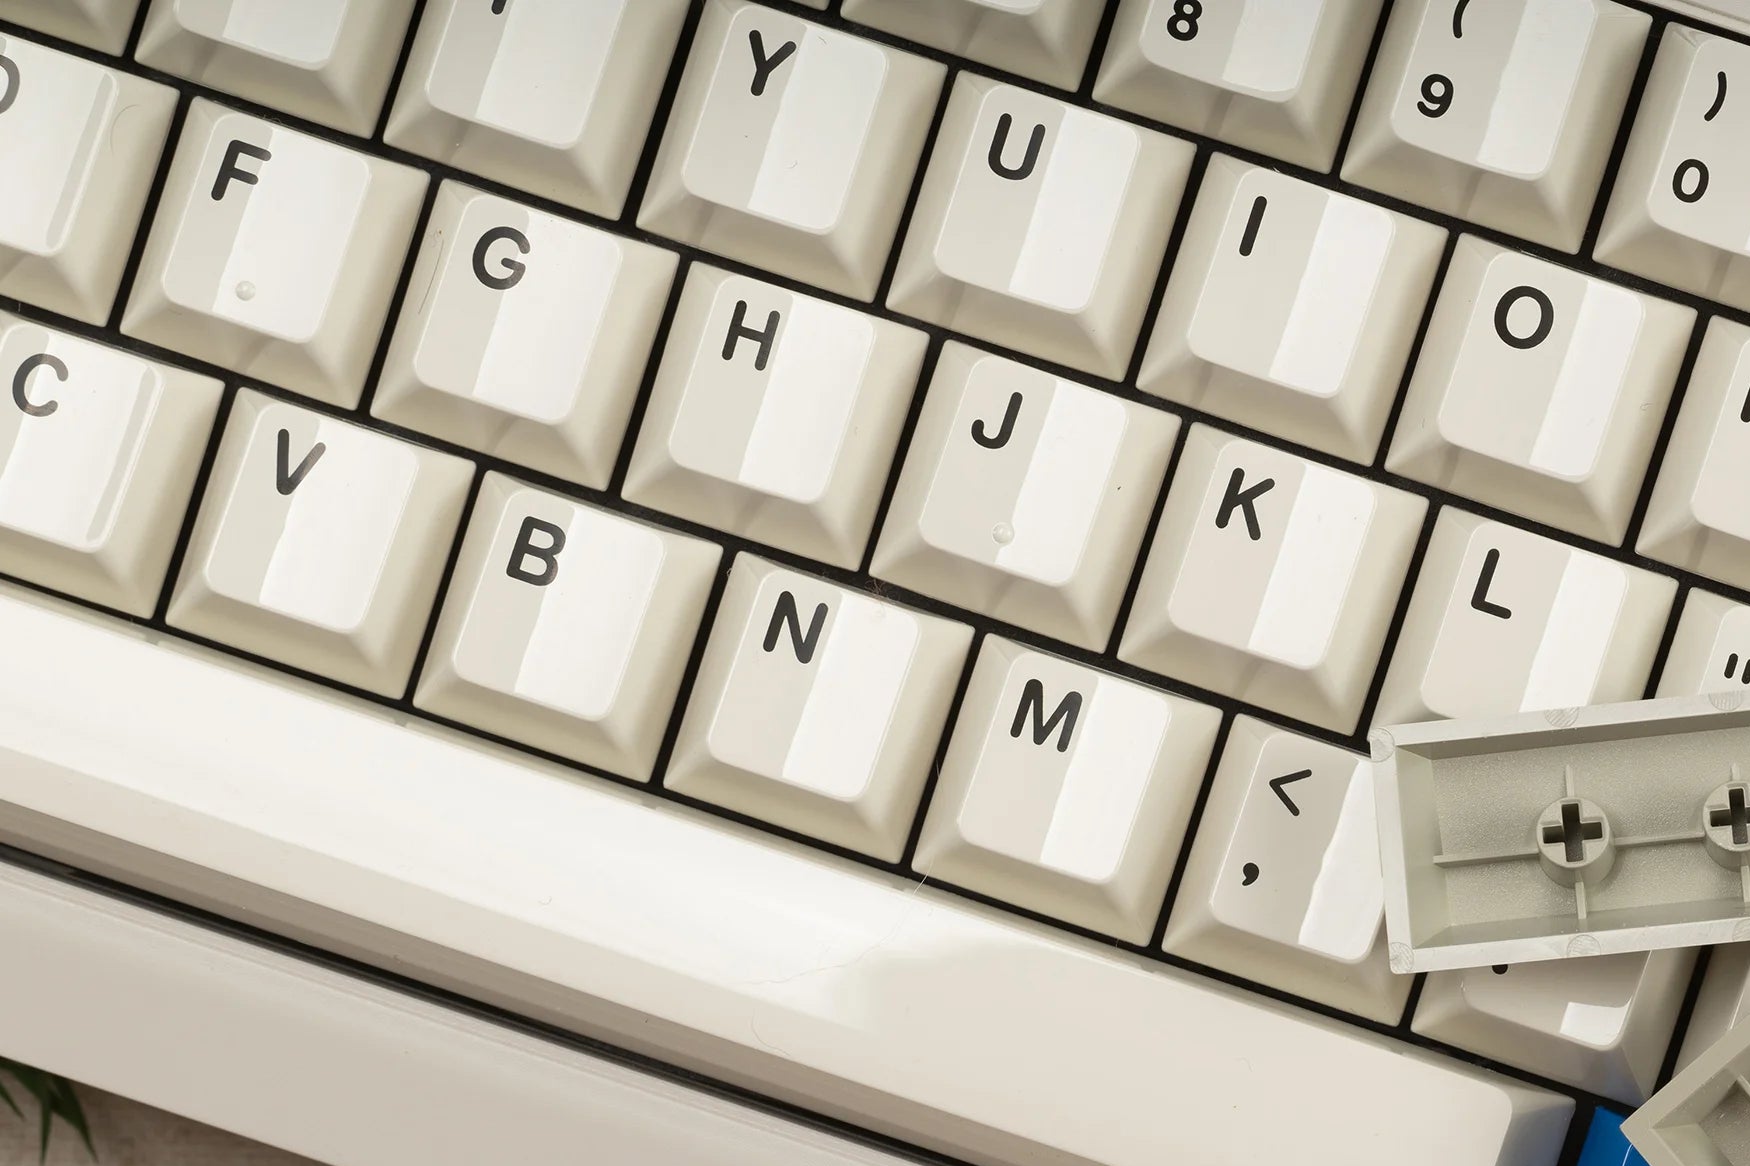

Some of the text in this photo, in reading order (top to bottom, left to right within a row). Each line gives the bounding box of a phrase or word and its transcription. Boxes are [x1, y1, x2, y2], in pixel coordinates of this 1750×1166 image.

[1167, 0, 1202, 41] 8
[749, 30, 796, 96] Y
[1417, 74, 1453, 118] 9
[1704, 72, 1727, 121] )
[211, 140, 271, 201] F
[988, 113, 1045, 180] U
[1239, 196, 1267, 256] I
[472, 227, 530, 290] G
[722, 300, 780, 371] H
[1494, 286, 1554, 349] O
[12, 354, 68, 417] C
[971, 392, 1022, 449] J
[276, 429, 325, 495] V
[1216, 468, 1275, 540] K
[506, 516, 566, 586] B
[1471, 549, 1511, 619] L
[763, 591, 829, 664] N
[1010, 679, 1082, 752] M
[1269, 769, 1312, 816] <
